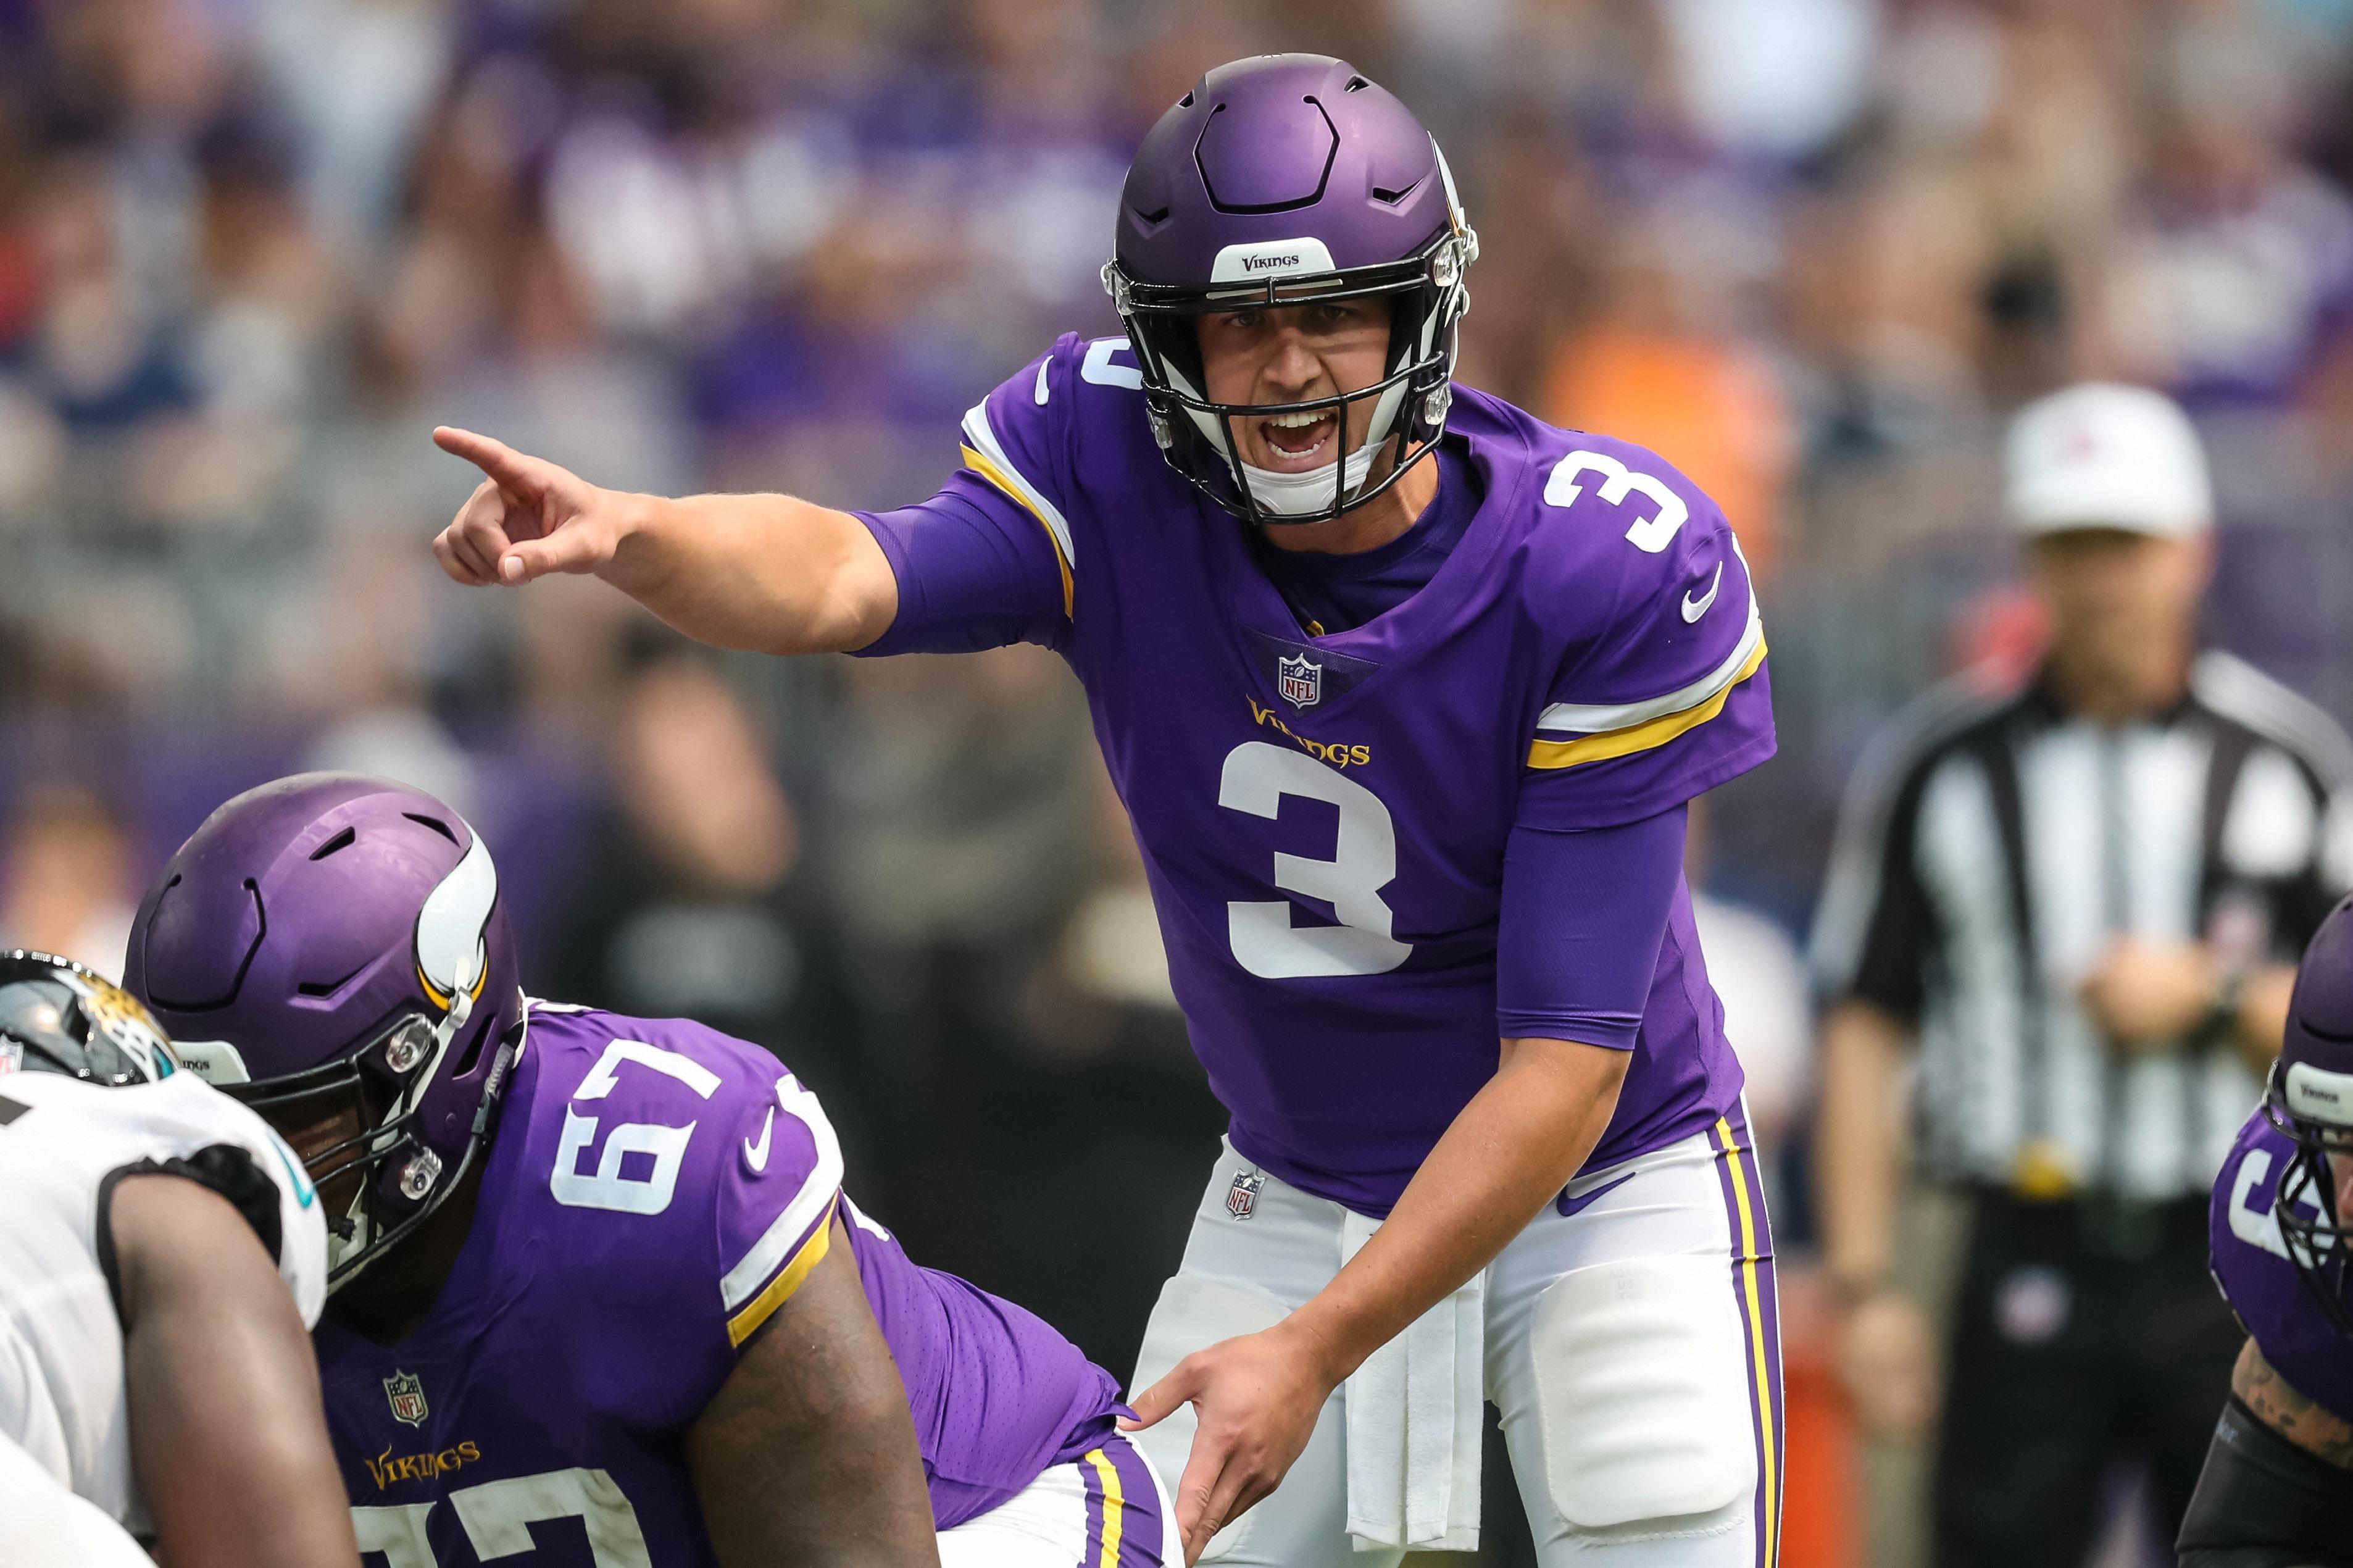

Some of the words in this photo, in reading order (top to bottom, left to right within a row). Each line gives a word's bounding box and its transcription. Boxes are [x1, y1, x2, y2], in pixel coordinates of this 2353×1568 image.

[1242, 252, 1299, 272] VIKINGS
[1543, 450, 1689, 553] 3
[1285, 678, 1314, 699] NFL
[1218, 741, 1414, 979] 3
[549, 1038, 723, 1216] 67
[1228, 1190, 1251, 1212] NFL
[395, 1395, 423, 1417] NFL
[363, 1441, 481, 1491] VIKINGS
